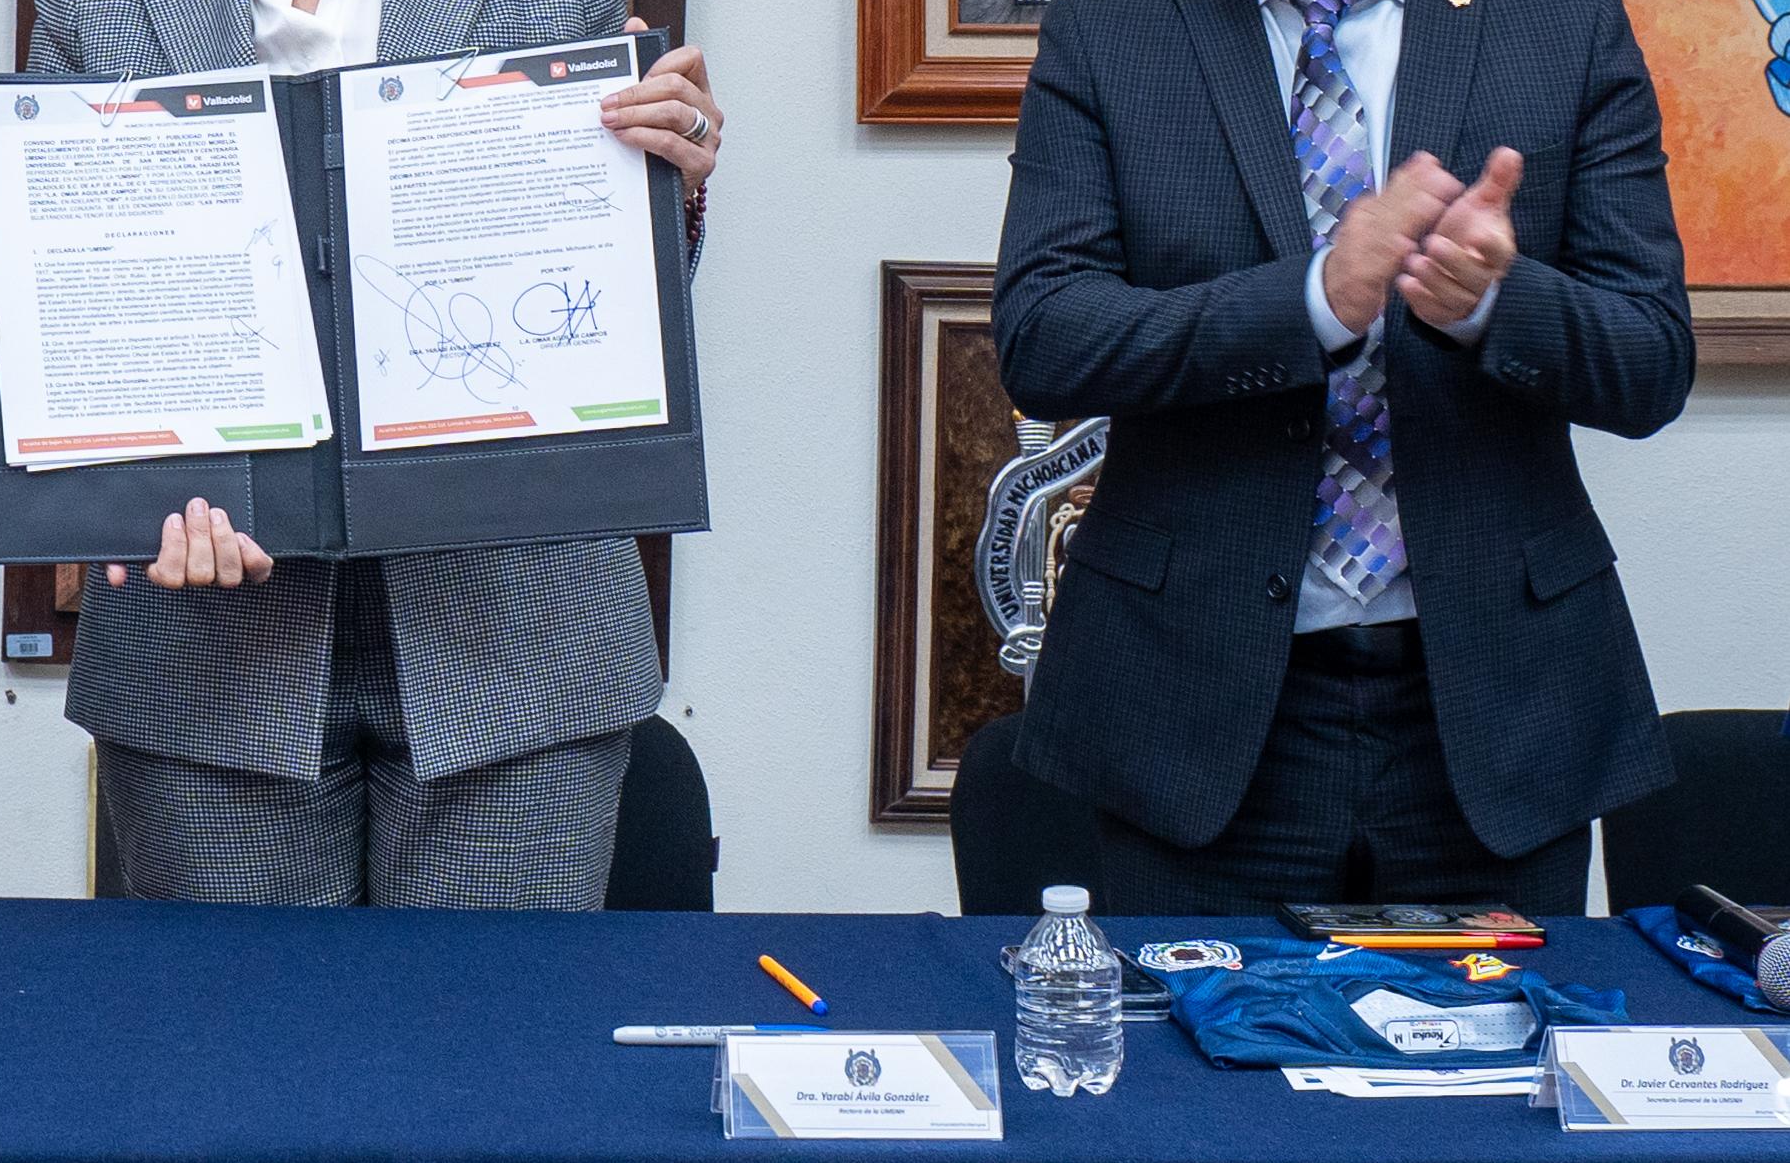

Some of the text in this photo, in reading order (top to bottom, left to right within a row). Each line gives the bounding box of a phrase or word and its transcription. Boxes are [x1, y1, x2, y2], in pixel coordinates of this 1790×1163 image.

[568, 59, 618, 73] Valladolid
[203, 94, 253, 107] Valladolid
[990, 437, 1102, 620] UNIVERSIDAD MICHOACANA
[1621, 1079, 1634, 1088] Dr.
[1637, 1079, 1666, 1089] Javier
[1668, 1079, 1717, 1089] Cervantes
[796, 1089, 930, 1102] Dra. Yarabí Ávila González
